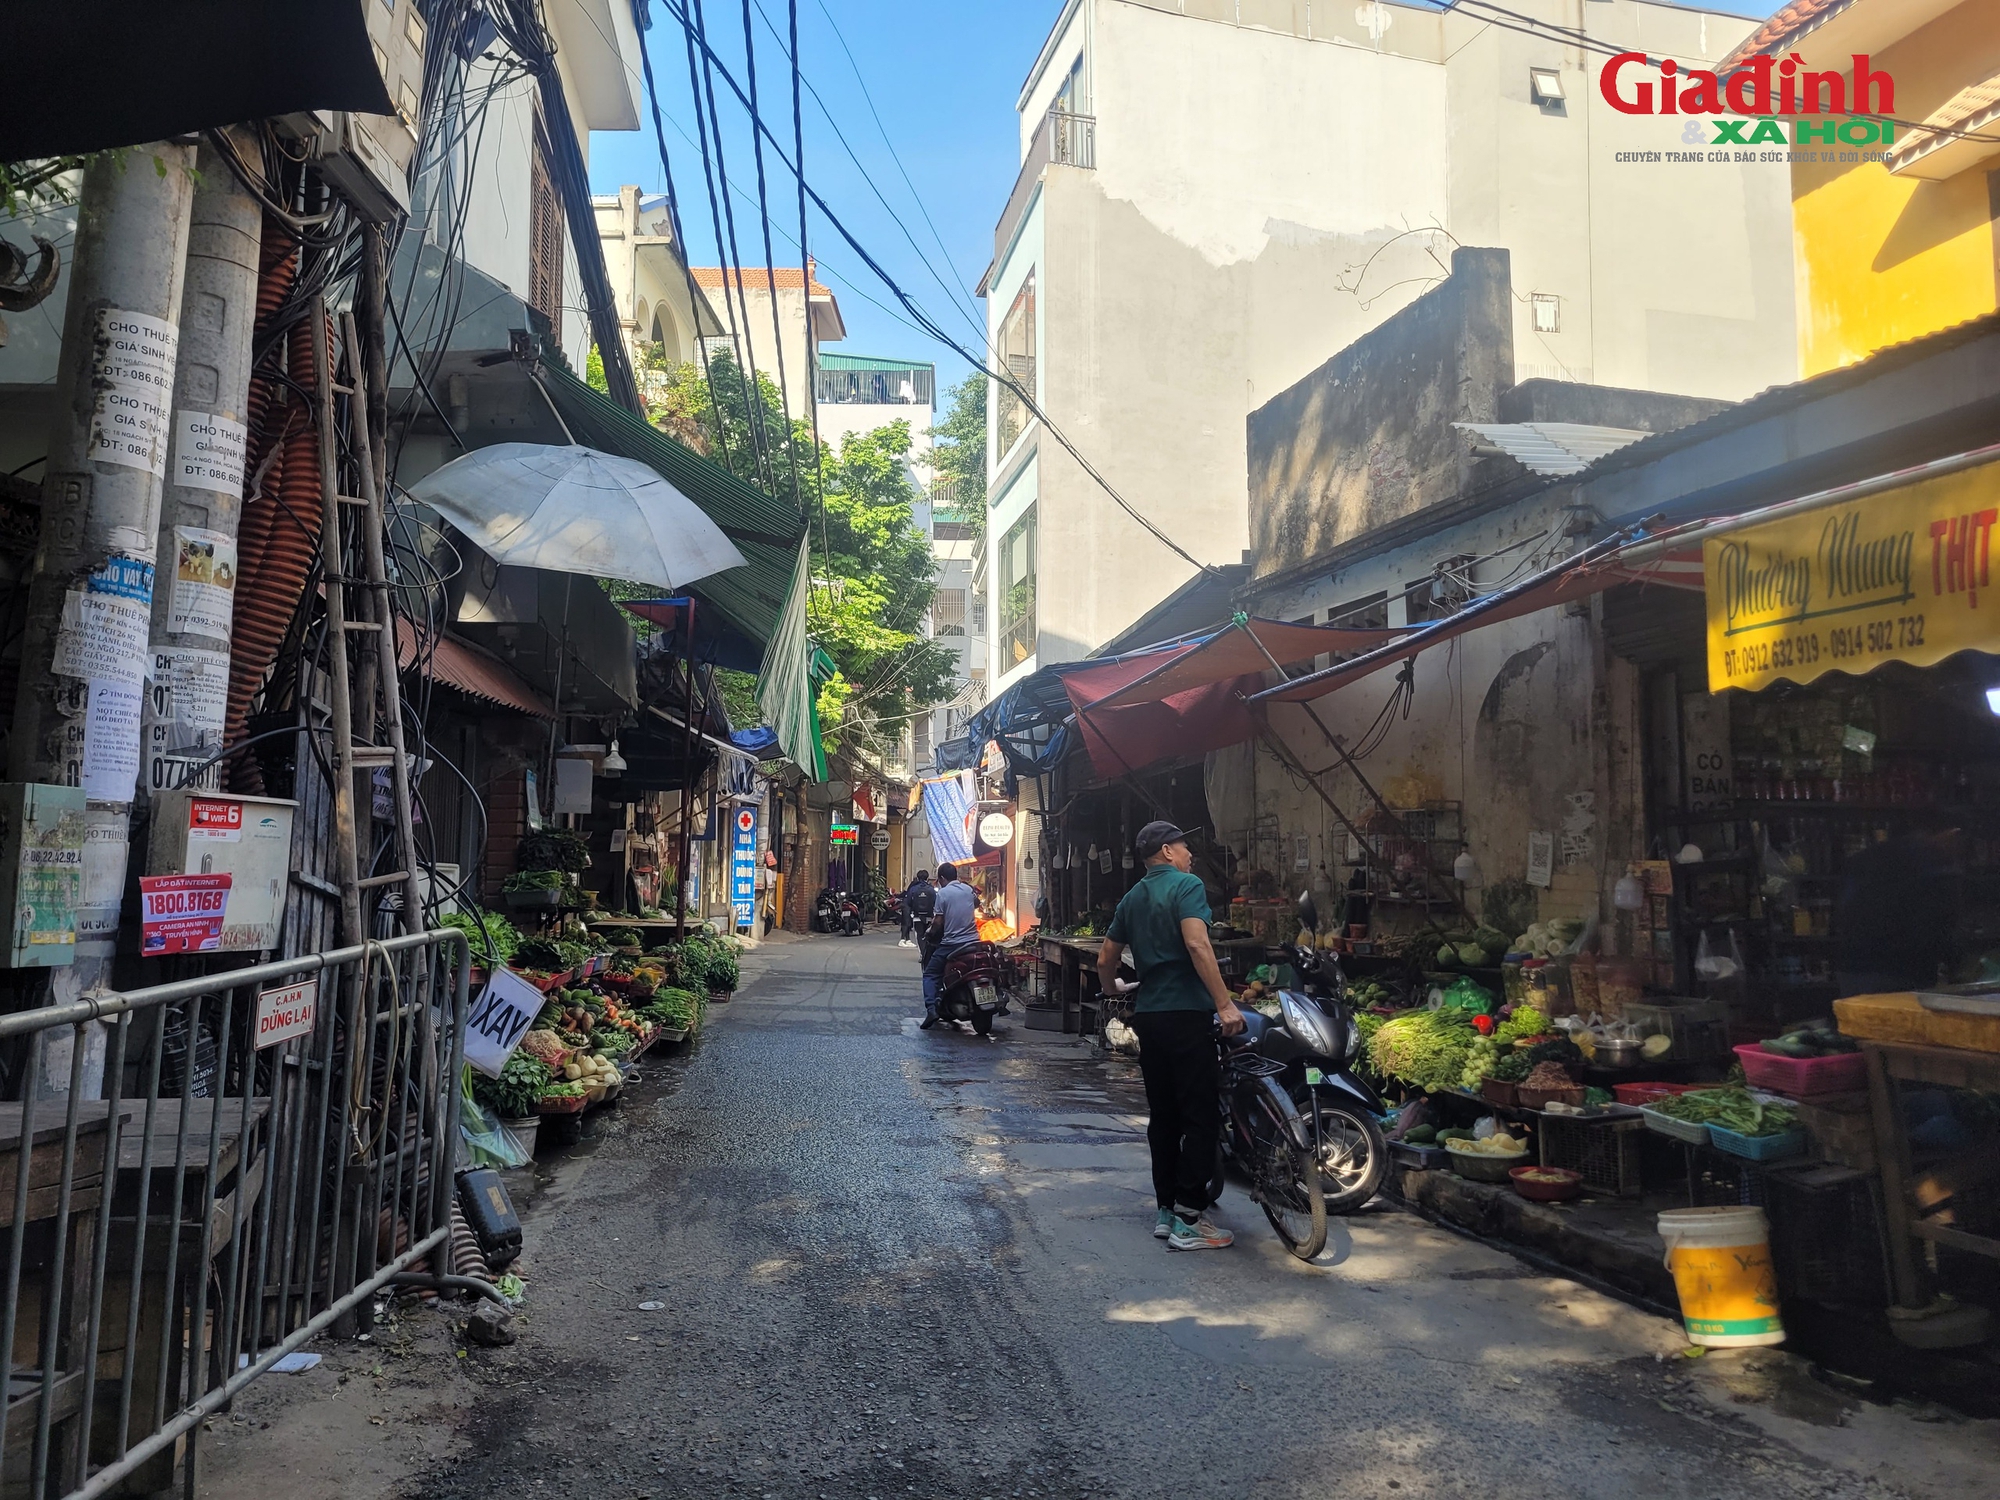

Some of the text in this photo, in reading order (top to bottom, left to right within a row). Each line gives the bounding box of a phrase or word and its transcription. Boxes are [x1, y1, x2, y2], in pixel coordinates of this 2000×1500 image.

[109, 321, 139, 335] CHO
[142, 327, 170, 345] THUÊ
[115, 341, 165, 361] GIÁ SINH
[110, 394, 167, 420] CHO THUÊ
[115, 413, 161, 435] GIÁ SNH
[190, 423, 217, 436] CHO
[220, 429, 241, 444] THUÊ
[100, 439, 123, 451] ĐT:
[185, 465, 206, 476] ĐT:
[1930, 508, 1998, 609] THỊT
[123, 567, 142, 587] VAY
[1718, 540, 1812, 635] Phương
[82, 599, 107, 611] CHO
[109, 604, 137, 620] THUÊ
[75, 620, 95, 631] DIỆN
[96, 624, 116, 636] TÍCH
[117, 630, 126, 638] 26
[116, 619, 127, 628] KÍN
[73, 629, 96, 641] NÓNG
[70, 639, 80, 647] SN
[82, 641, 95, 650] 49,
[97, 644, 115, 654] NGÕ
[1725, 649, 1741, 677] ĐT:
[1742, 642, 1769, 674] 0912
[1771, 638, 1794, 669] 632
[1796, 633, 1819, 664] 919
[1830, 625, 1864, 659] 0914
[1867, 620, 1893, 653] 502
[1897, 614, 1925, 647] 732
[155, 654, 170, 670] CH
[95, 714, 107, 722] HỒ
[96, 707, 113, 716] MỘT
[68, 725, 86, 742] CH
[1696, 749, 1723, 771] CÓ
[1692, 773, 1730, 794] BÁN
[194, 803, 239, 823] INTERNET 6
[210, 814, 227, 823] WIFI
[738, 831, 752, 844] NHÀ
[155, 878, 220, 888] LẮP ĐẶT INTERNET
[147, 891, 224, 915] 1800.8168
[159, 923, 186, 931] CAMERA
[165, 929, 190, 939] TRUYỀN
[275, 990, 302, 1006] C.A.H.N
[261, 1004, 311, 1034] DỪNG LẠI
[470, 991, 531, 1049] XAY
